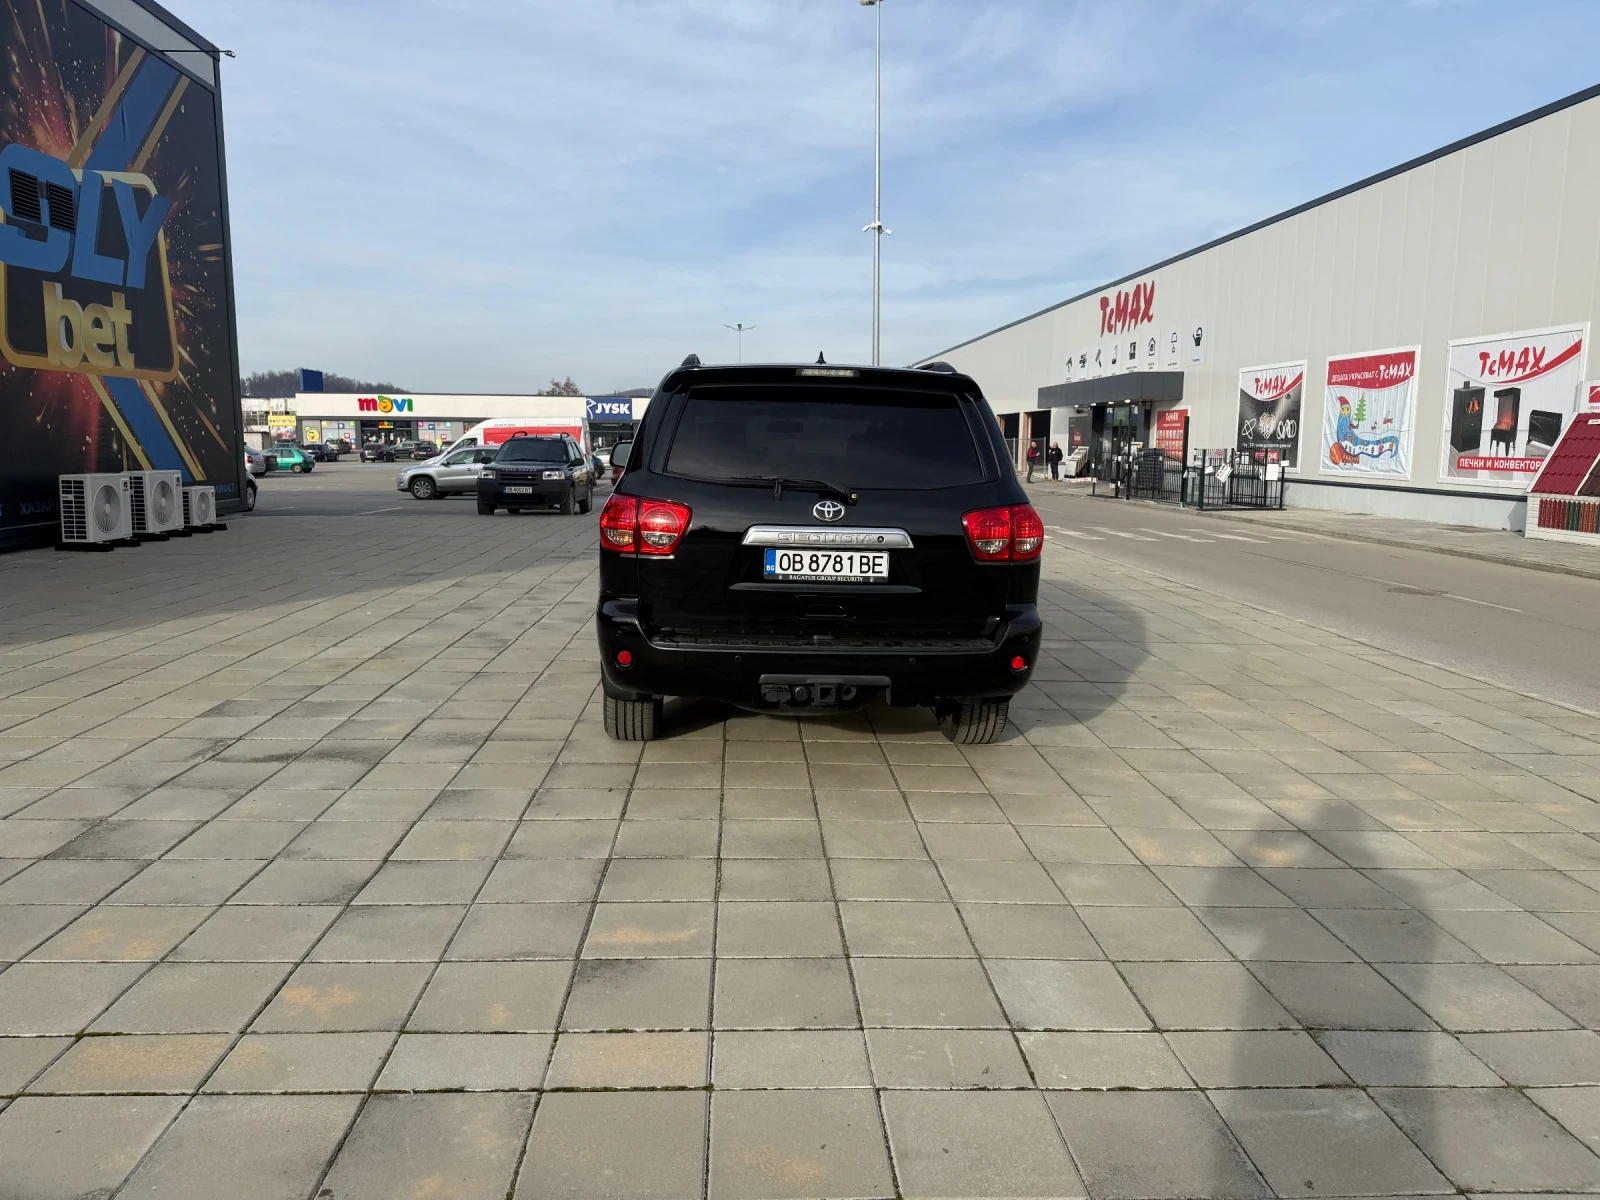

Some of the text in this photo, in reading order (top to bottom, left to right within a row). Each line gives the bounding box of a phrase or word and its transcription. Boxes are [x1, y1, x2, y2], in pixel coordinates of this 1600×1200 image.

[42, 280, 135, 371] bet
[1479, 345, 1546, 377] TeMAX
[595, 403, 631, 415] JYSK
[1459, 458, 1544, 470] ПЕЧКИ И КОНВЕКТОР
[777, 532, 877, 545] SEQUOIA
[766, 564, 775, 572] BG
[779, 553, 884, 574] OB 8781 BE
